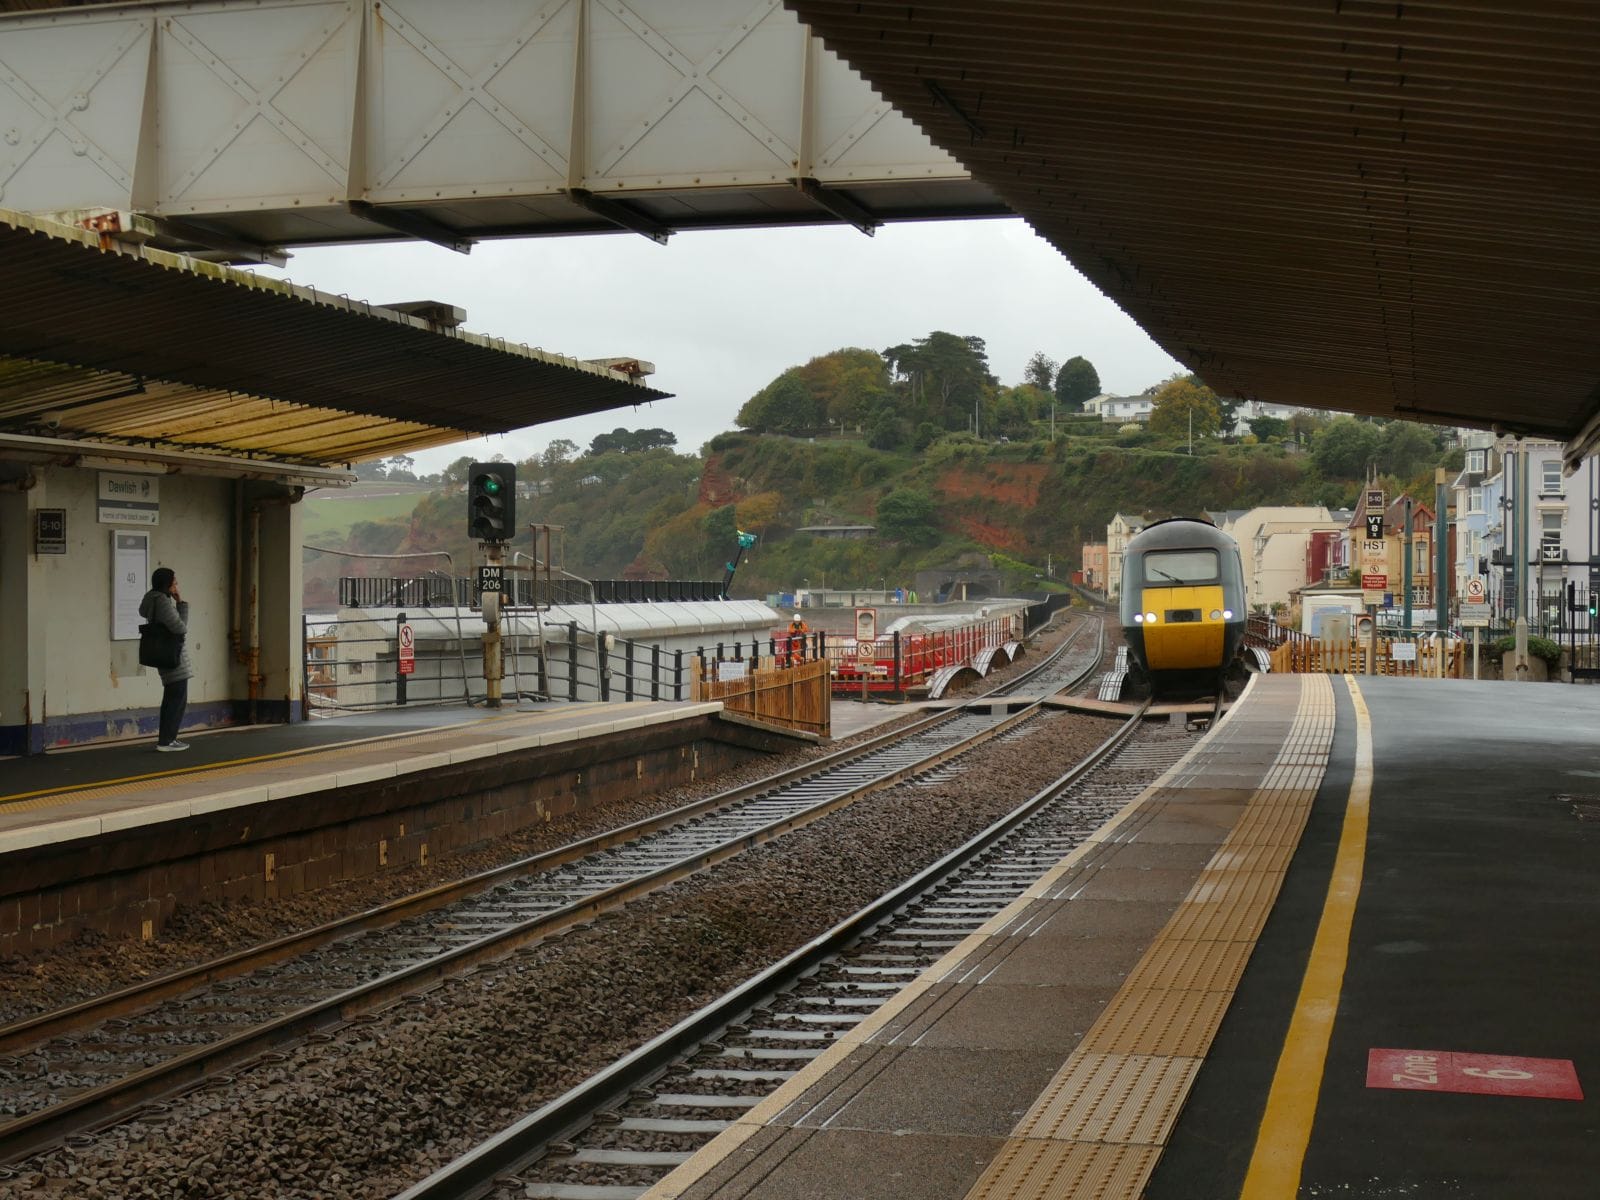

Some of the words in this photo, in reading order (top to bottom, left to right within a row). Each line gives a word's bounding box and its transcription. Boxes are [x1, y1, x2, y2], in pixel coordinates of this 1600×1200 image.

[108, 480, 137, 494] Dawlish
[41, 520, 61, 530] 5-10
[1367, 516, 1382, 524] VT
[1363, 540, 1386, 550] HST
[482, 567, 500, 578] DM
[482, 580, 501, 590] 206
[1392, 1055, 1438, 1084] Zone
[1462, 1067, 1535, 1080] 6
